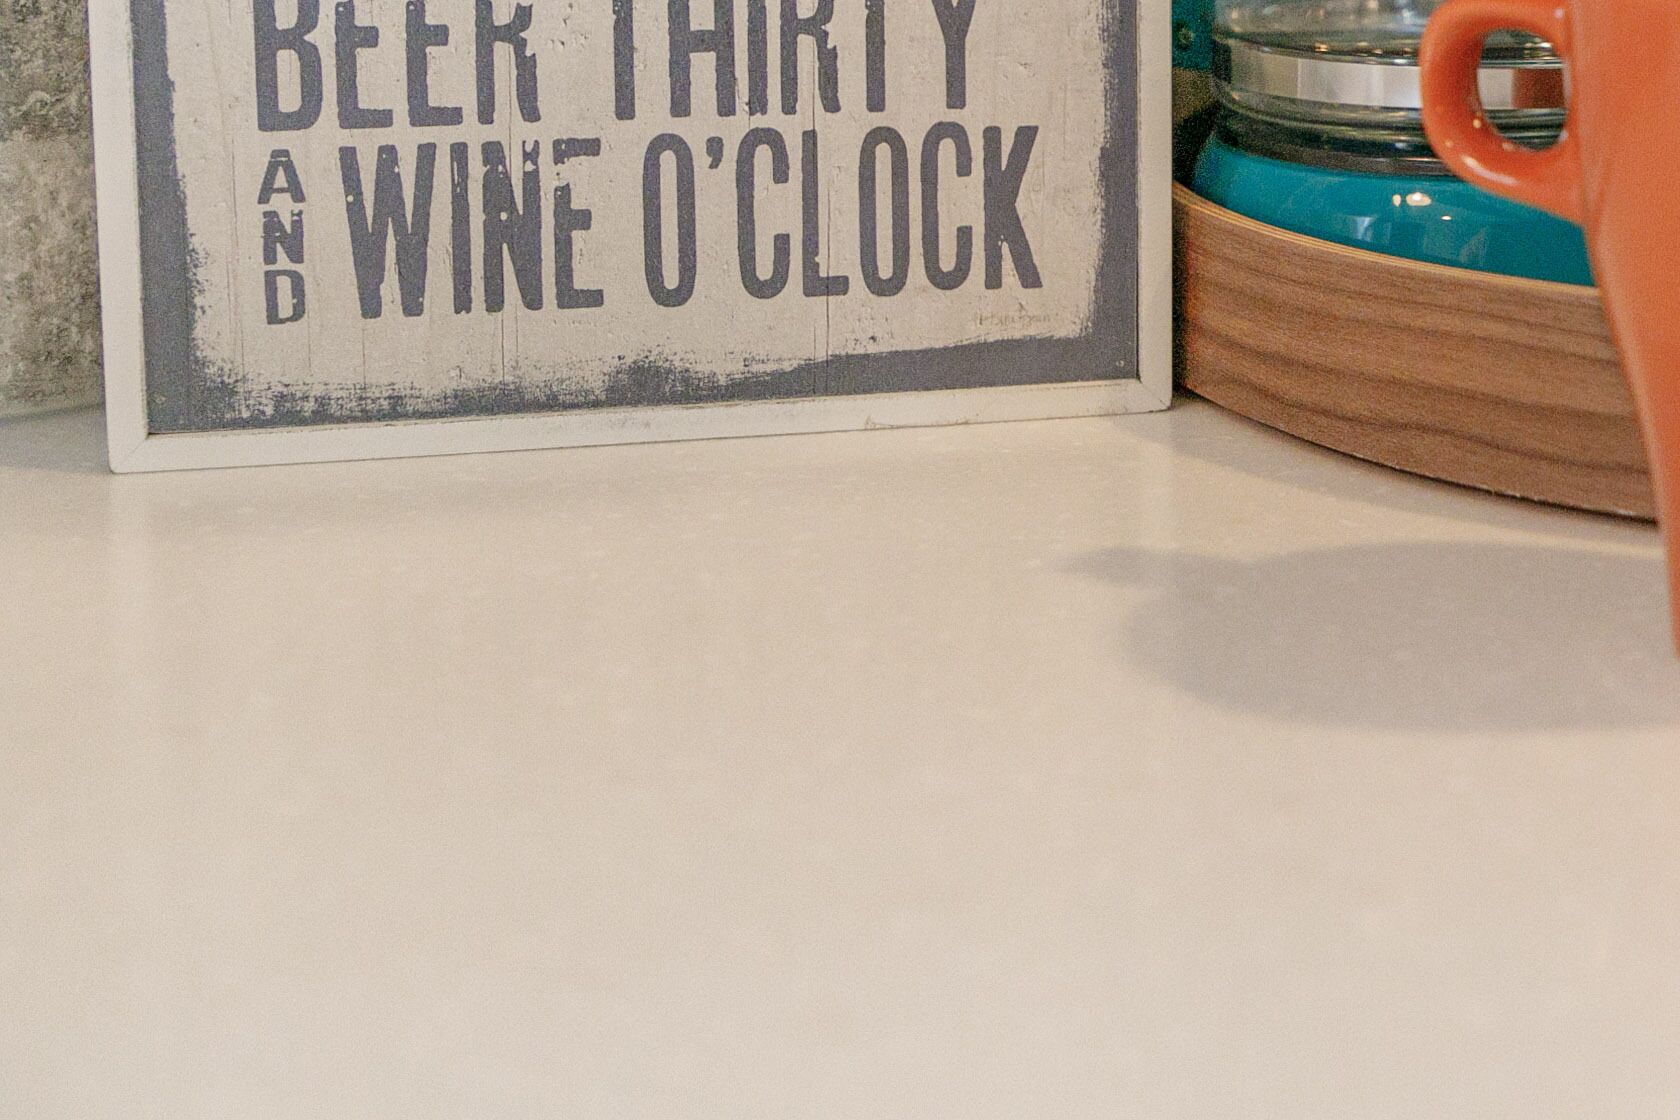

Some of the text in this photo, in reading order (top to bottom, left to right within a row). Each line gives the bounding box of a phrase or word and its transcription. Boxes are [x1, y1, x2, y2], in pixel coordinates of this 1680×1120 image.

[258, 148, 306, 326] AND
[338, 122, 1043, 319] WINE O'CLOCK
